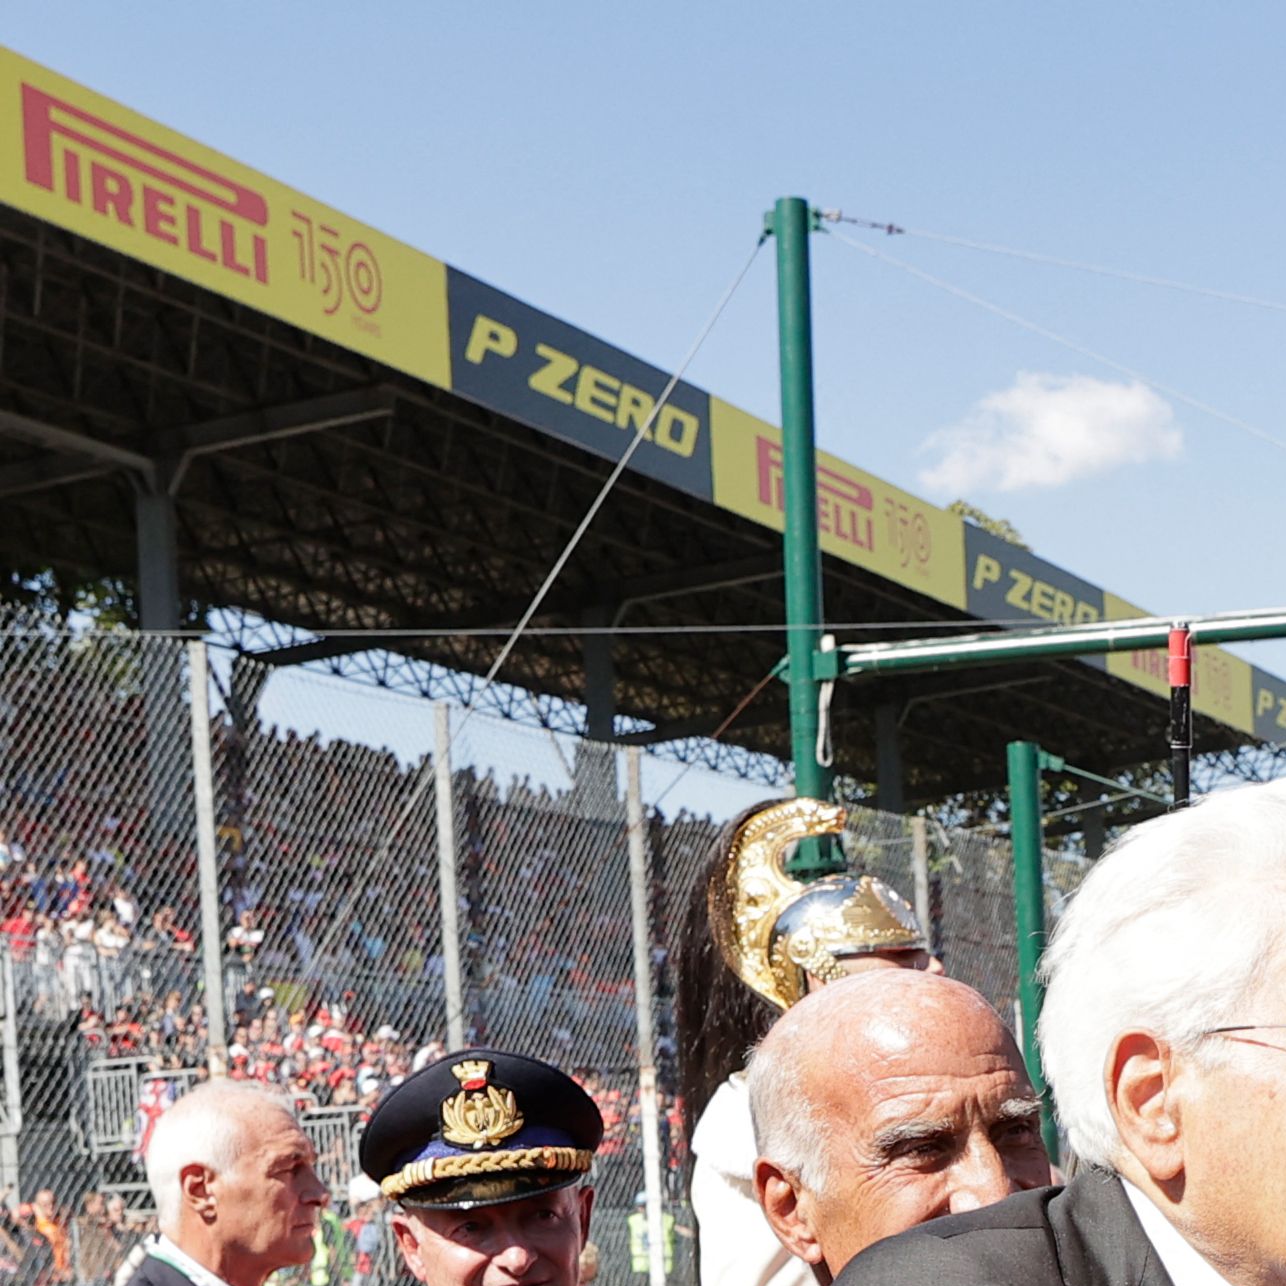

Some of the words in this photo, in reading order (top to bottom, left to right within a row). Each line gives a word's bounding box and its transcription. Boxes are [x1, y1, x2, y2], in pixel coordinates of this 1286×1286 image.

[21, 81, 269, 286] PIRELLI
[291, 209, 382, 315] 150
[465, 313, 518, 365] P
[528, 343, 699, 458] ZERO
[756, 434, 874, 553] PIELLI
[972, 553, 1002, 590] P
[1257, 688, 1274, 717] P
